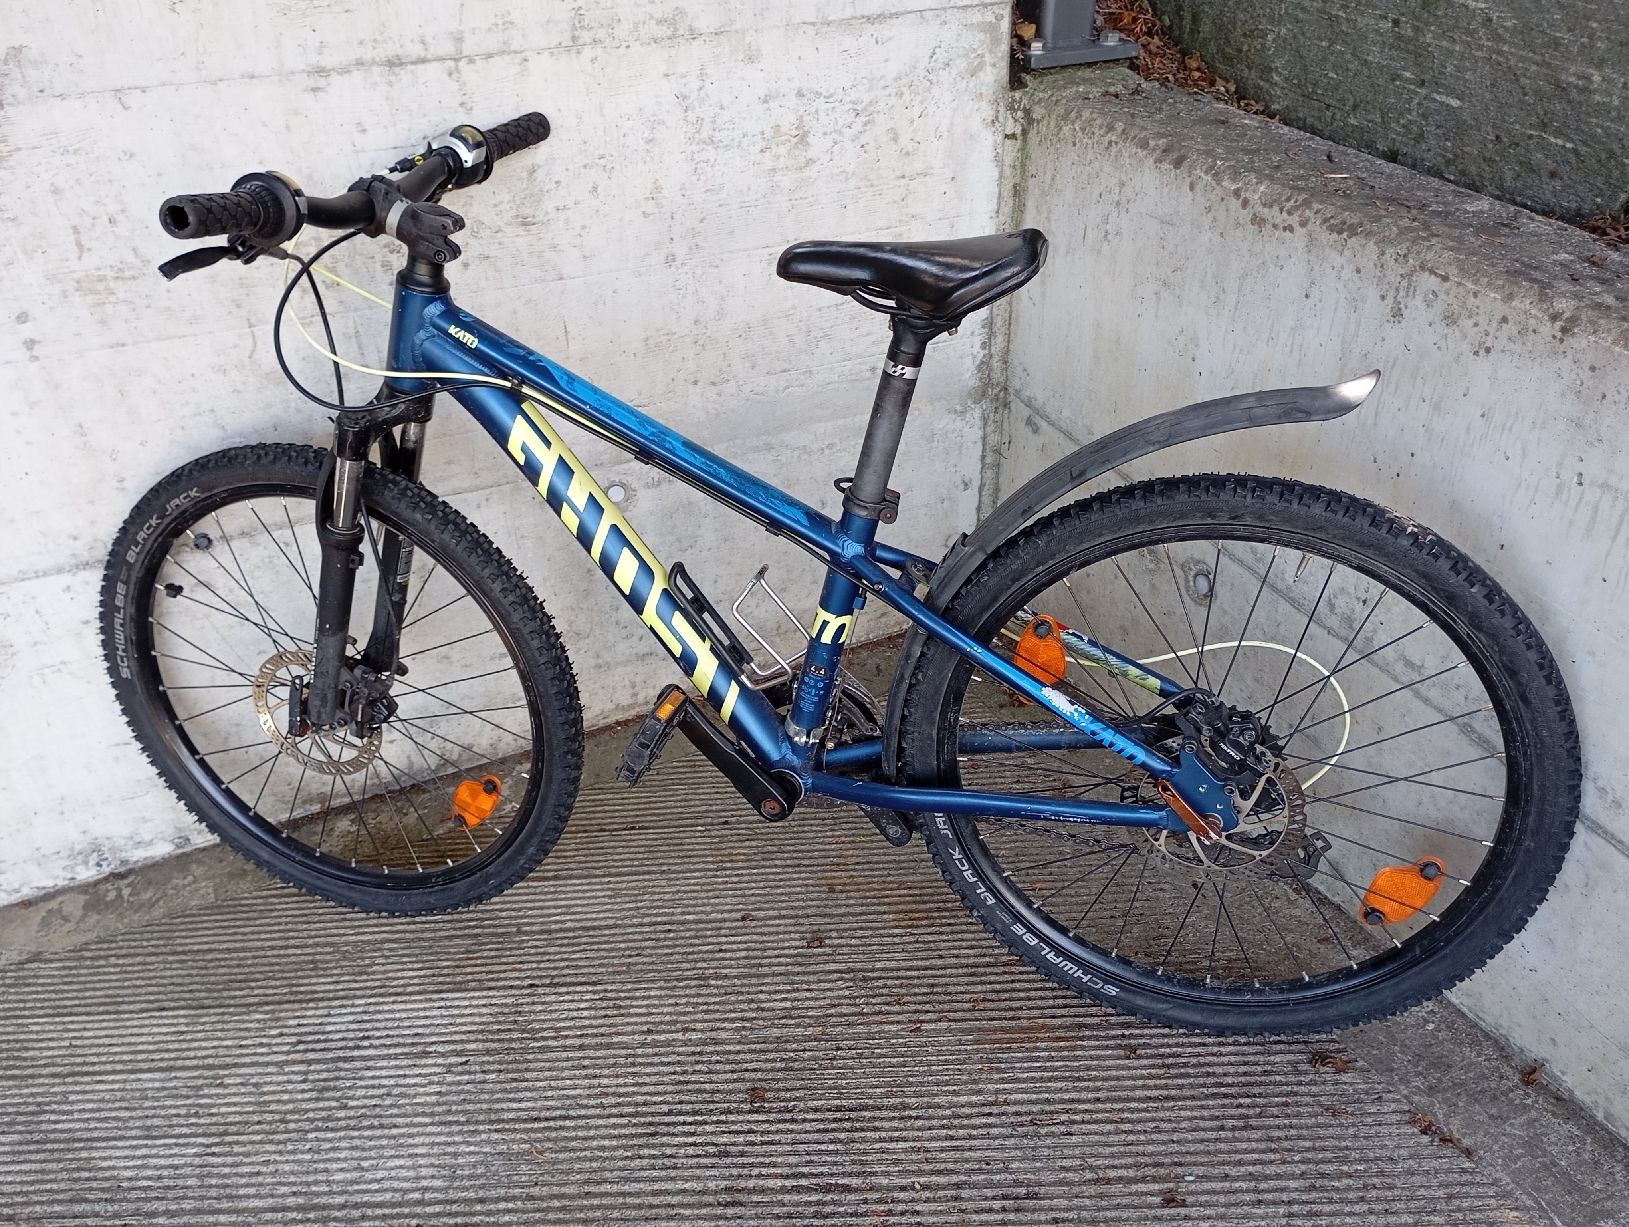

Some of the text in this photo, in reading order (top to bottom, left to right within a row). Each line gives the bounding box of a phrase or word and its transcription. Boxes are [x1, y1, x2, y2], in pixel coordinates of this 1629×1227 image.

[447, 324, 479, 349] KATO
[114, 486, 200, 680] SCHWALBE BLACK JACK
[507, 402, 740, 725] GHOST
[947, 846, 996, 906] BLACK
[1010, 922, 1121, 996] SCHWALBE
